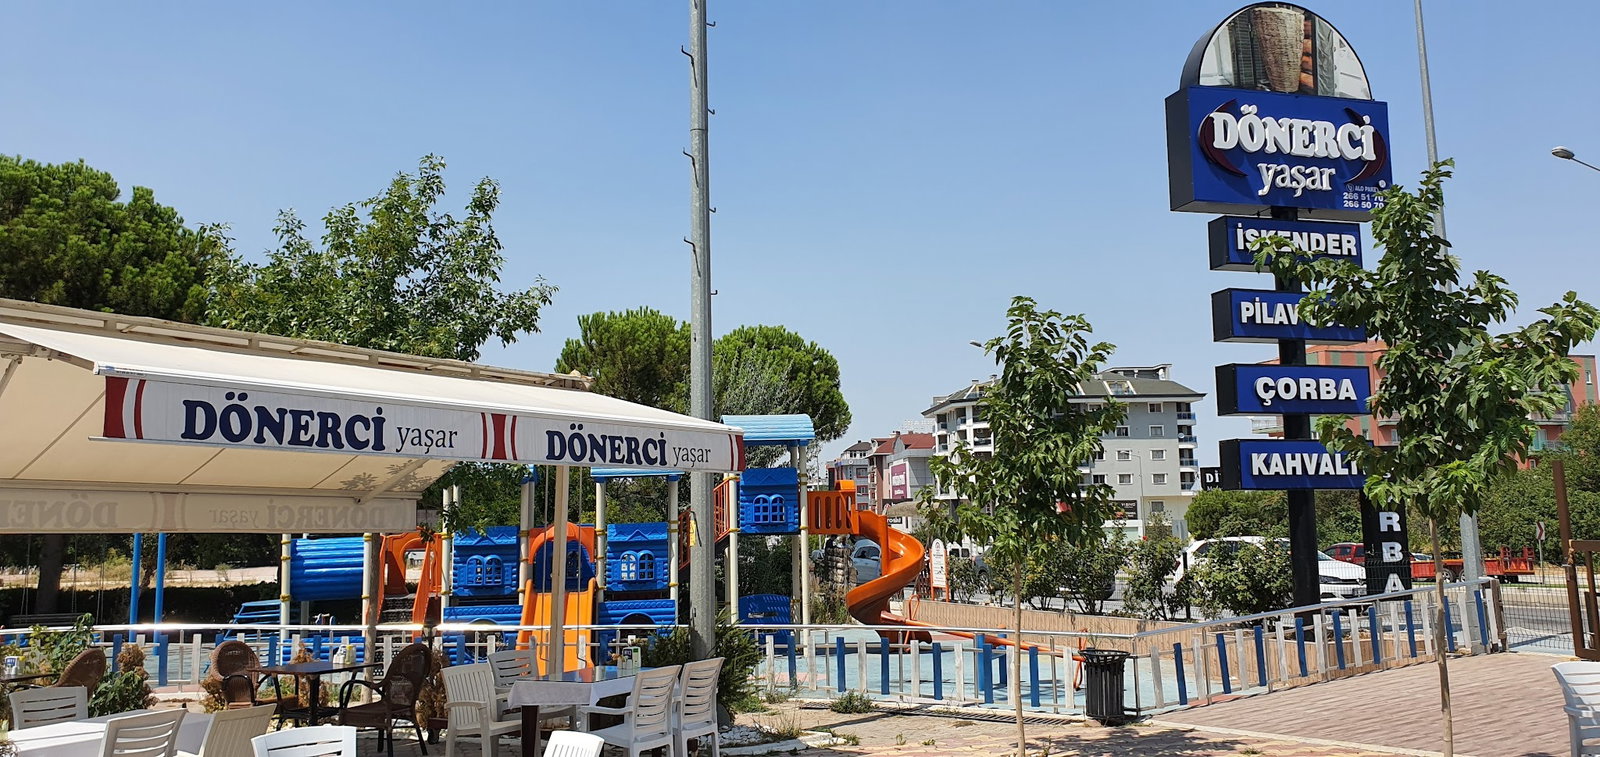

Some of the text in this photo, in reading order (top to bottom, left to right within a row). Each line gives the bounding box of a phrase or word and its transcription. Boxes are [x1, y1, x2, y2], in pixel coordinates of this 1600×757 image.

[1209, 104, 1377, 161] DÖNERCİ
[1257, 163, 1336, 197] yaşar
[1343, 192, 1359, 200] 266
[1343, 200, 1359, 208] 266
[1256, 377, 1357, 406] ÇORBA
[181, 391, 458, 454] DÖNERCİ yaşar
[546, 423, 711, 467] DÖNERCİ yaşar
[1205, 470, 1221, 483] Dİ
[1251, 453, 1367, 476] KAHVAL
